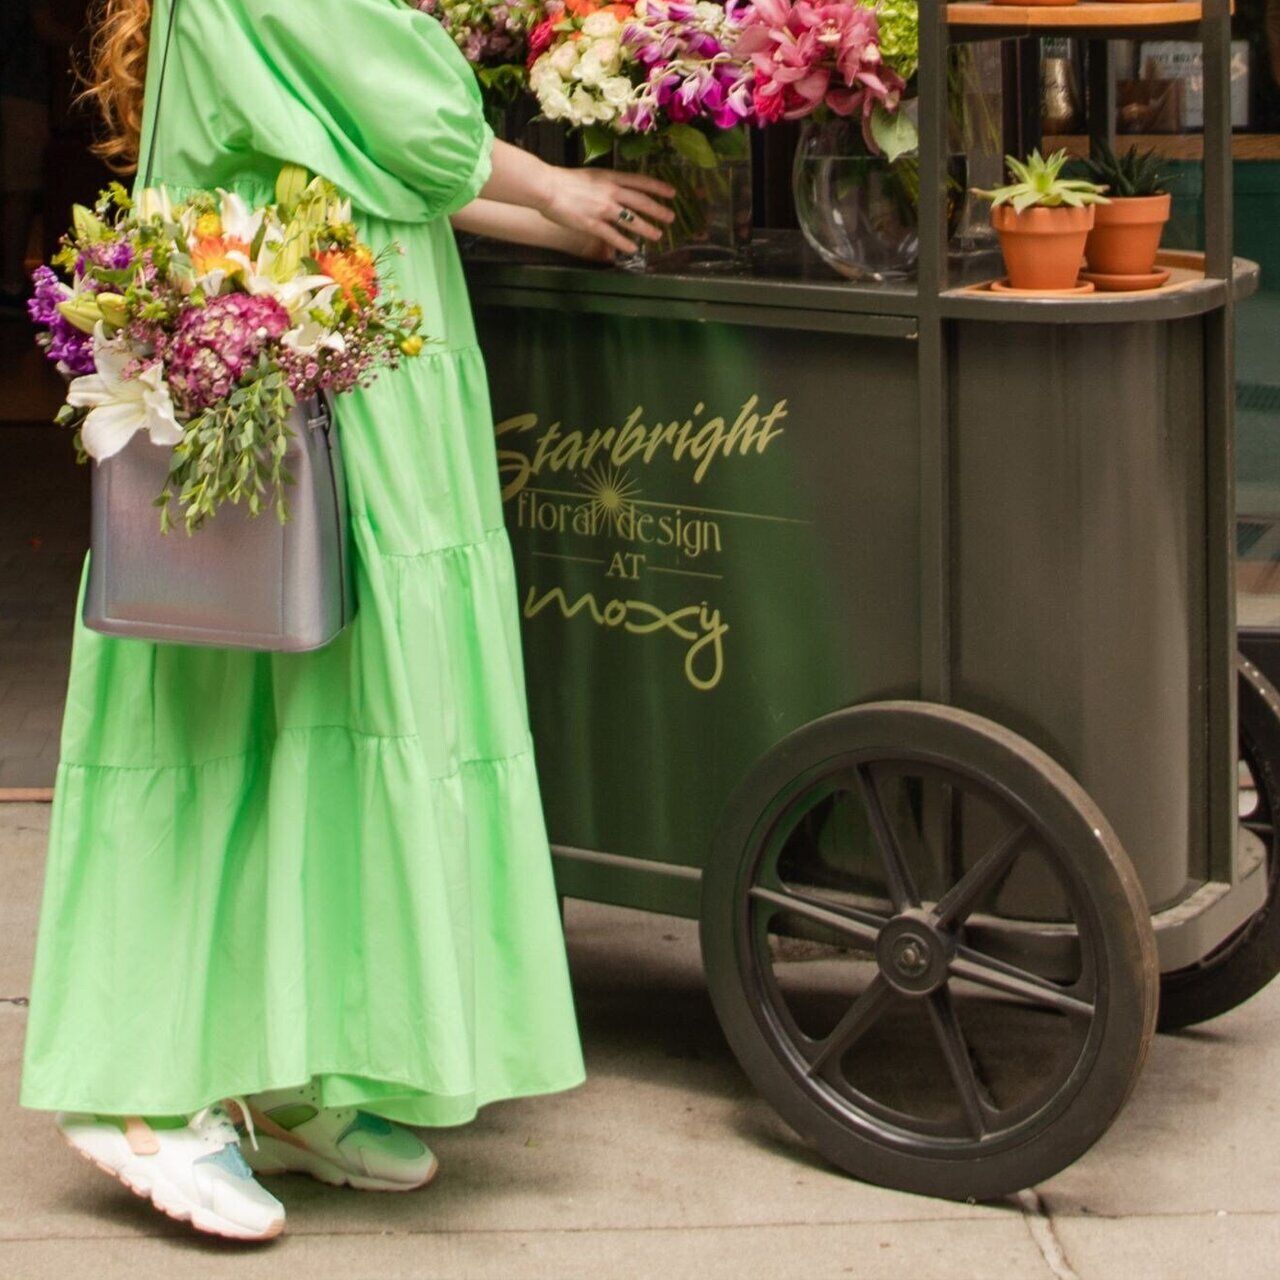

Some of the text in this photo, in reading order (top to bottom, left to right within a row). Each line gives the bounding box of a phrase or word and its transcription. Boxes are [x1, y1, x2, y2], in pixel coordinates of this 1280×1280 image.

[494, 394, 788, 502] Starbright
[517, 491, 723, 558] floral design
[606, 552, 647, 580] AT
